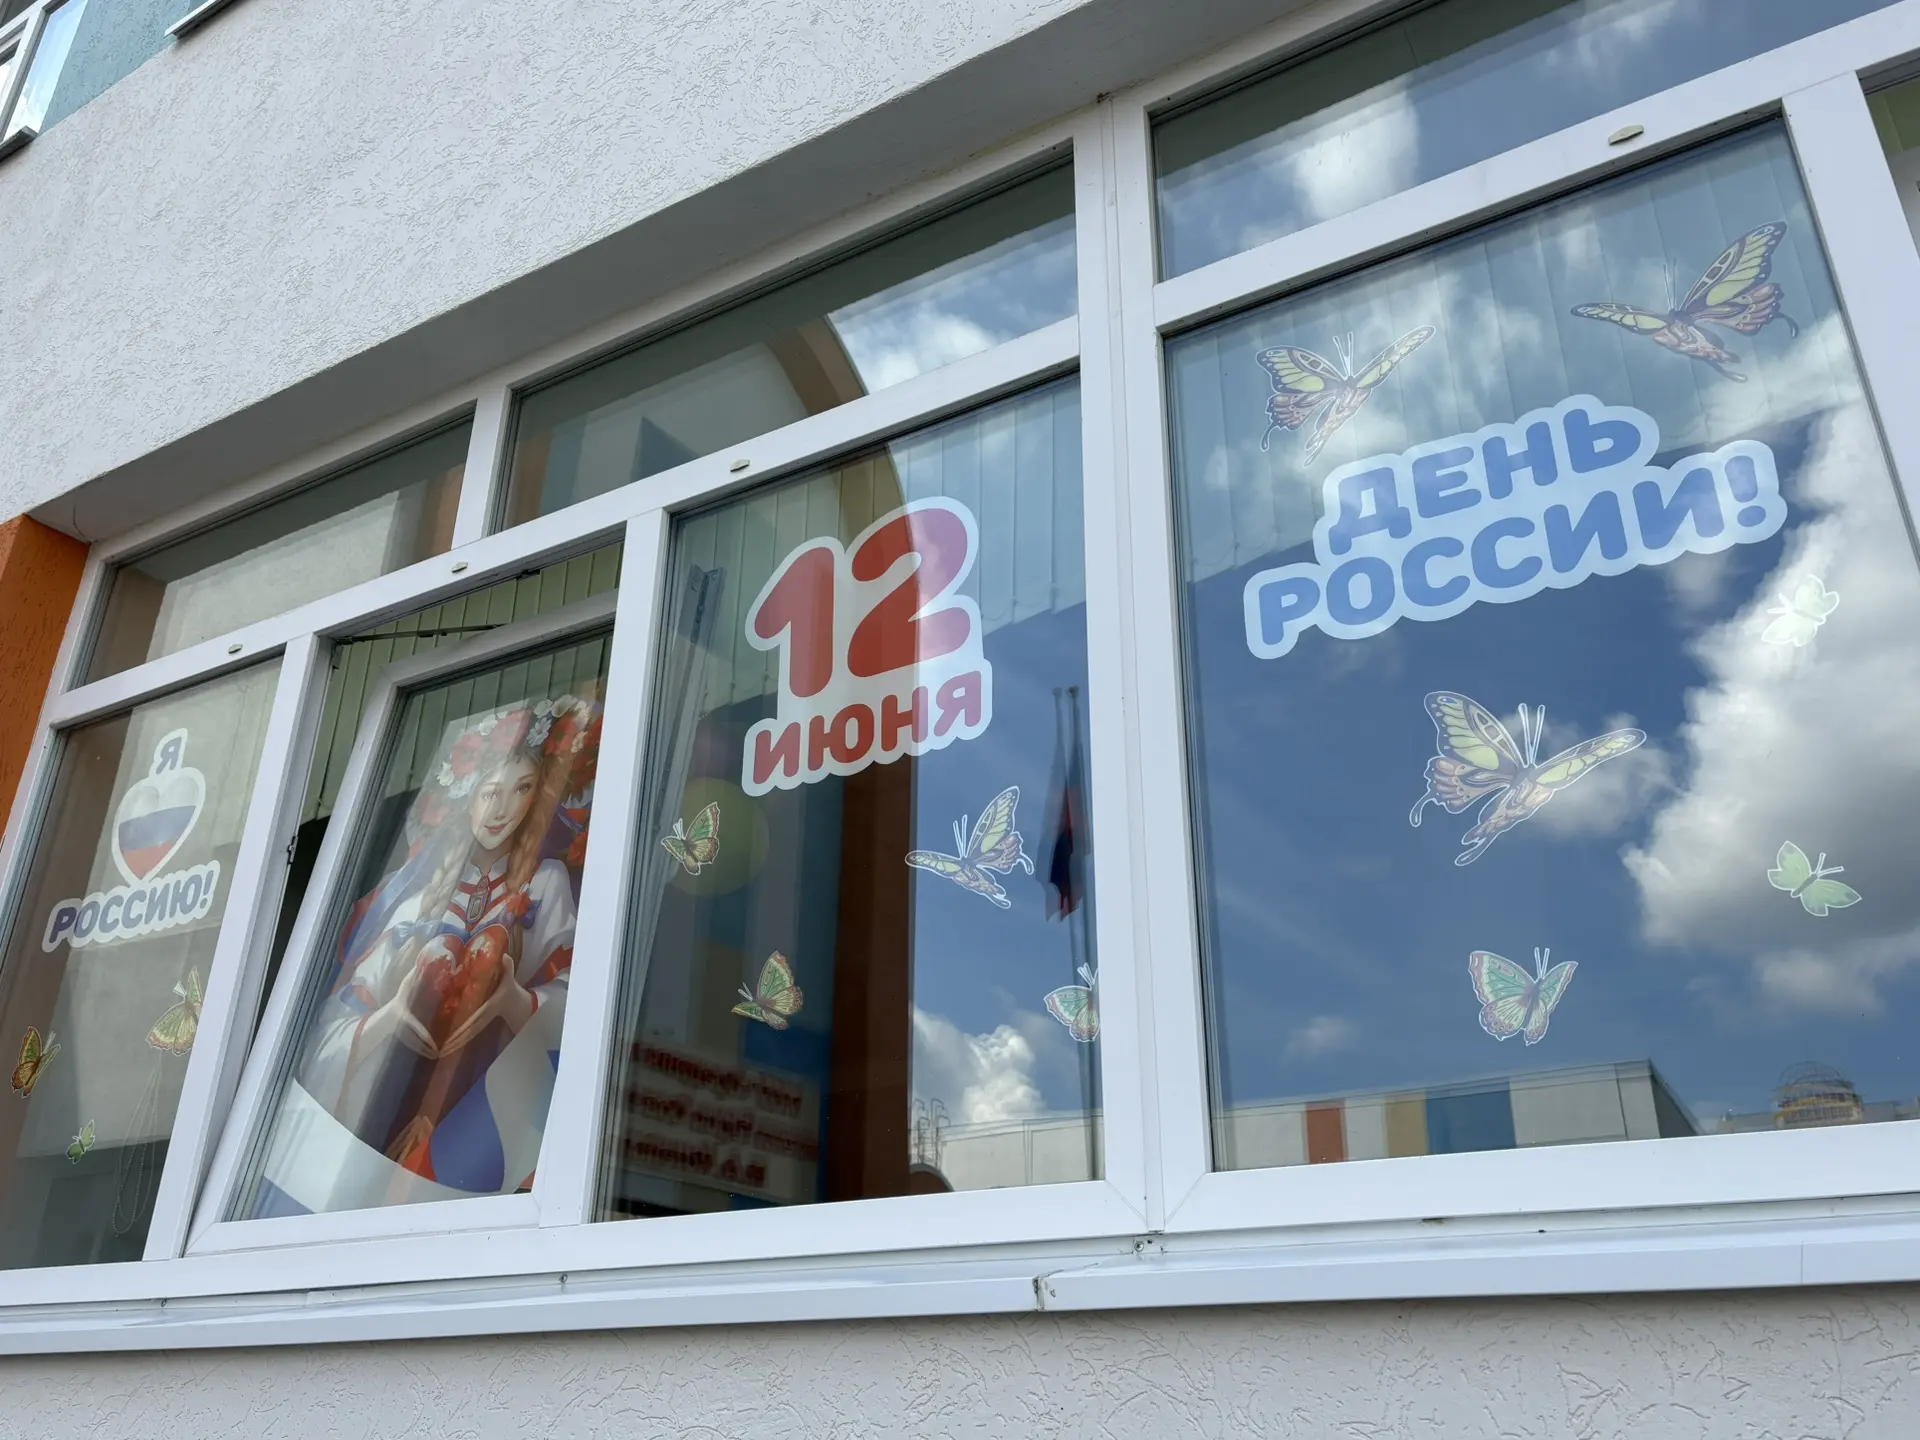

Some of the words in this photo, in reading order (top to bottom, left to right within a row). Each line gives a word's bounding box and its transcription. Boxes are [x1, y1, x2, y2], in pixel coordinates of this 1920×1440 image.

[1328, 409, 1641, 555] ДЕНЬ
[754, 508, 968, 698] 12
[1259, 455, 1767, 645] РОССИИ!
[156, 736, 182, 774] Я
[753, 670, 981, 784] ИЮНЯ
[49, 870, 214, 943] РОССИЮ!
